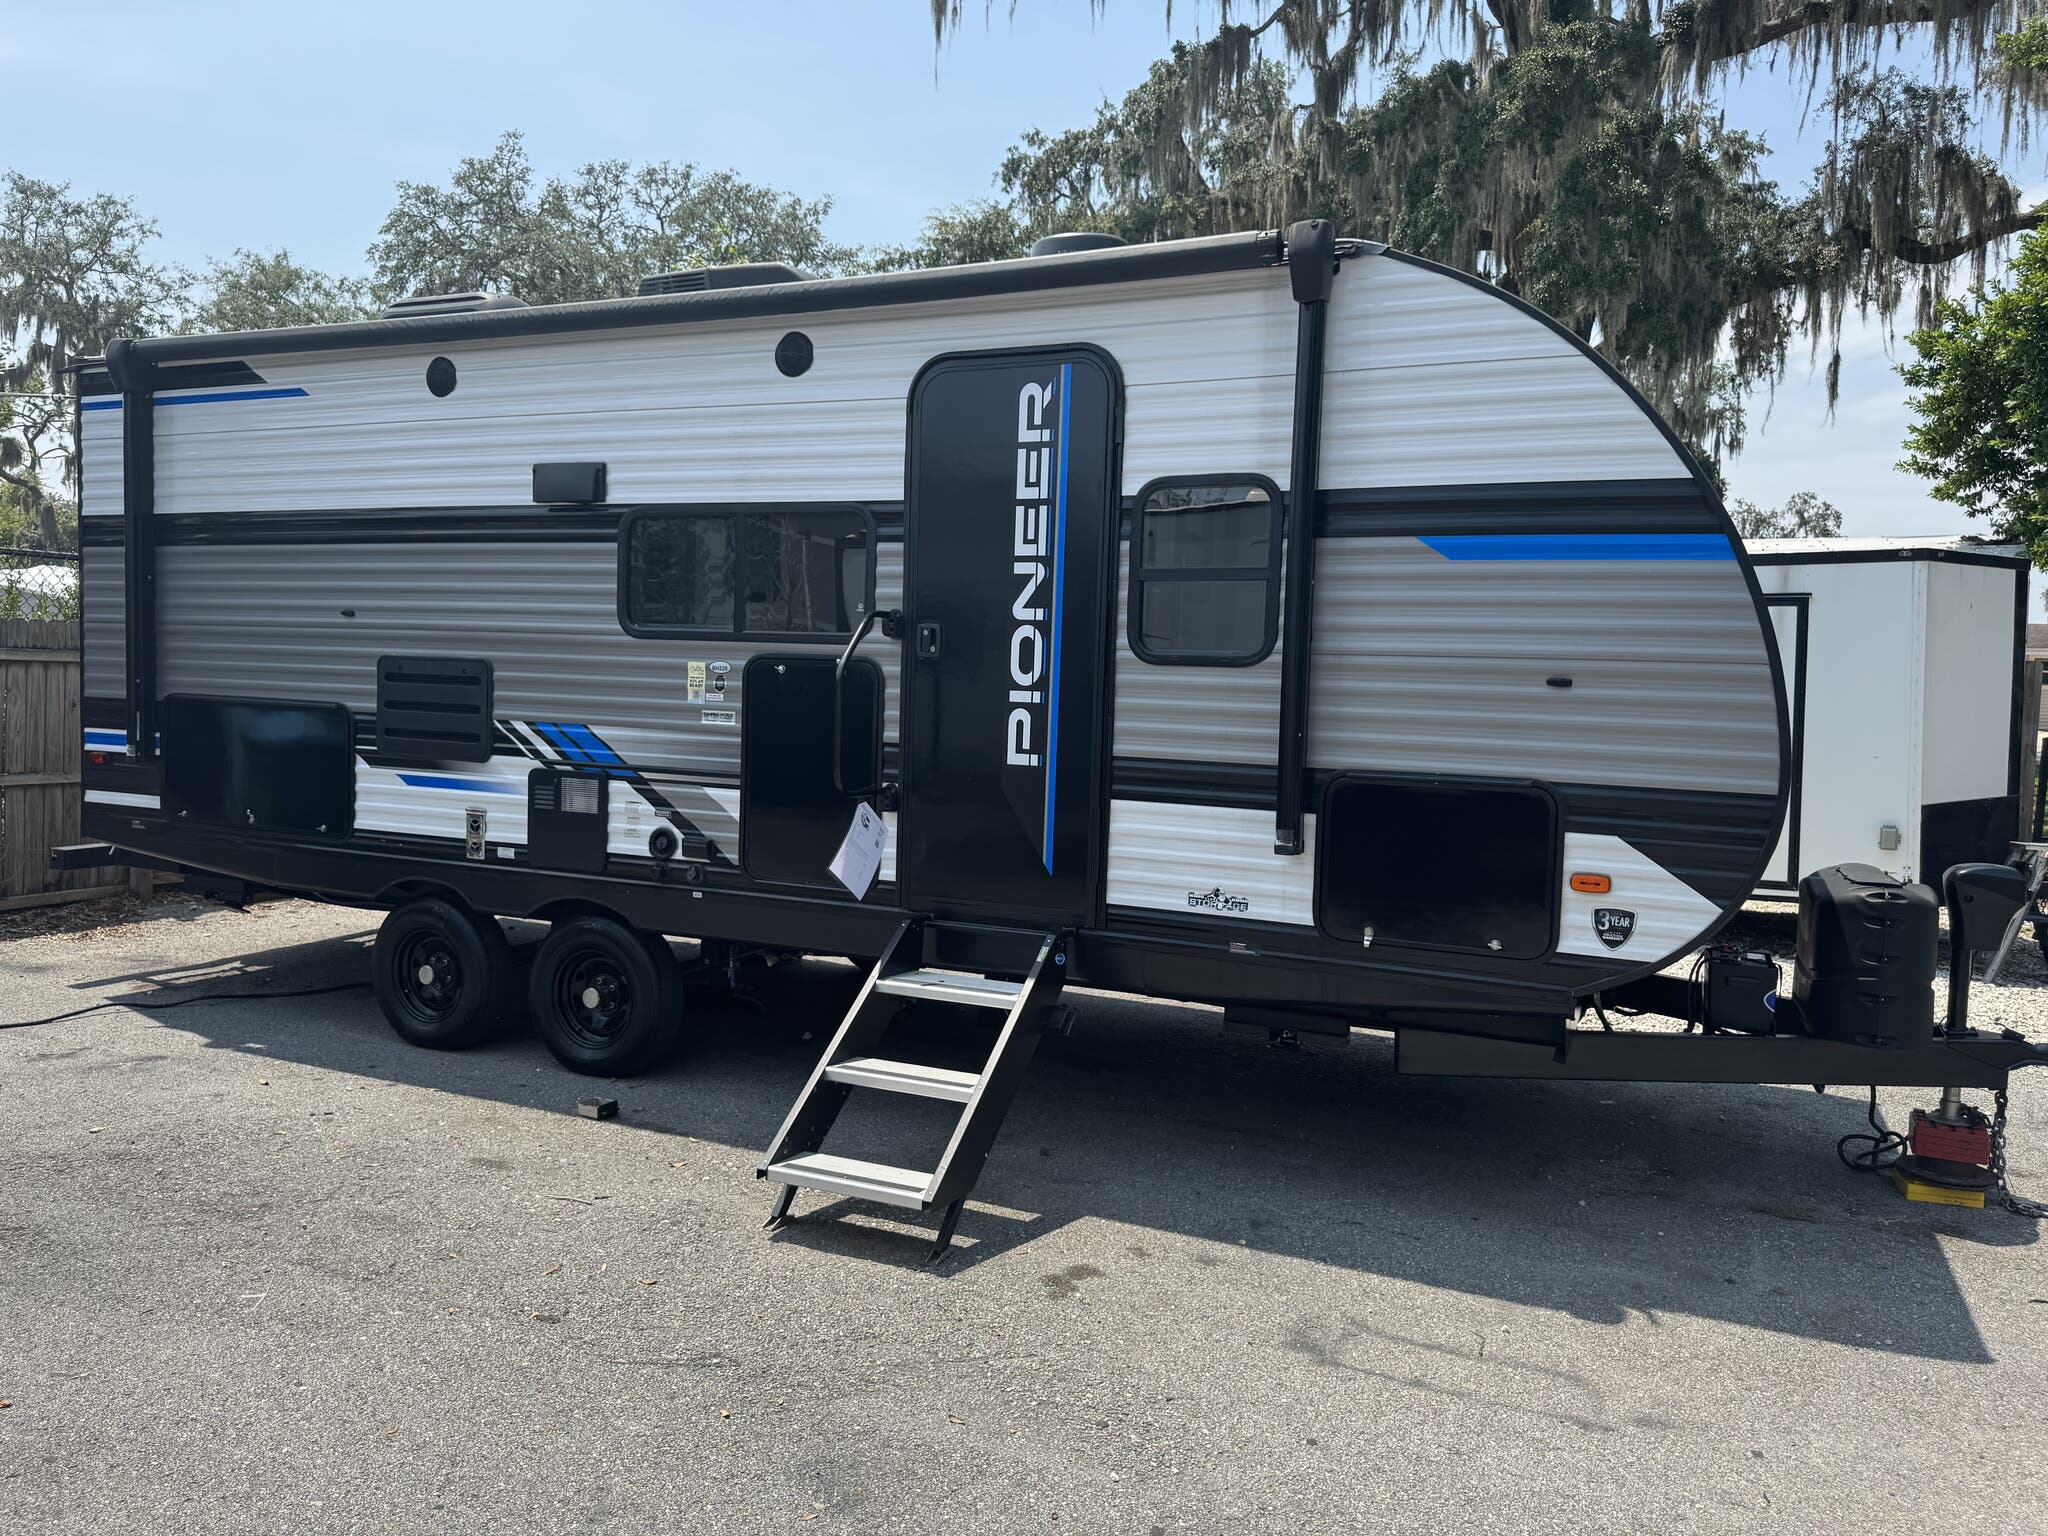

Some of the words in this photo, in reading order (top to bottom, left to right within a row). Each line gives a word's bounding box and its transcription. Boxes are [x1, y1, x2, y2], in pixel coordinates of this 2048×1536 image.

[1006, 378, 1055, 767] PIONEER
[1597, 911, 1610, 931] 3
[1610, 915, 1630, 927] YEAR
